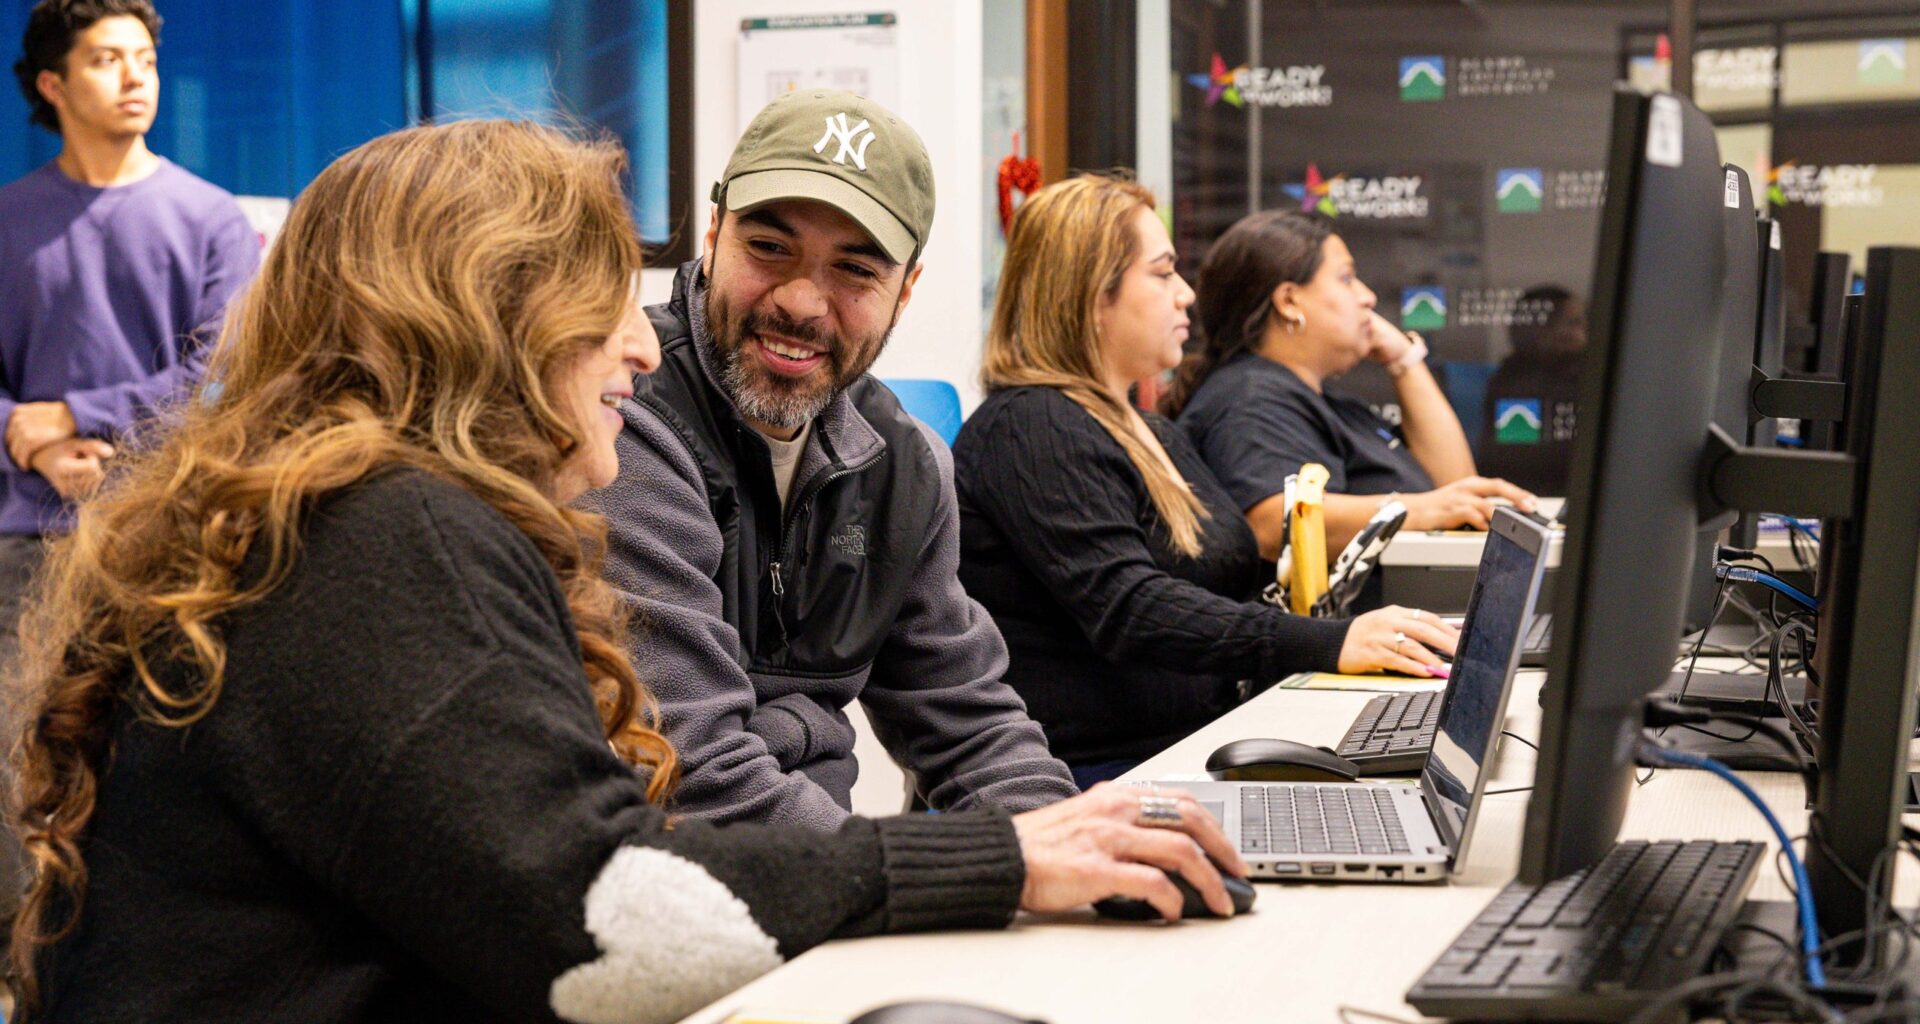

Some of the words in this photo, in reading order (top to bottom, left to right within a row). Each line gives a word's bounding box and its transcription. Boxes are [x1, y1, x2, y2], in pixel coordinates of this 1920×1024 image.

[1692, 47, 1777, 74] EADY
[1233, 65, 1326, 90] READY
[813, 112, 876, 171] NY
[1328, 176, 1422, 201] READY
[831, 535, 861, 545] NORTH
[846, 525, 861, 534] THE
[842, 545, 862, 555] FACE
